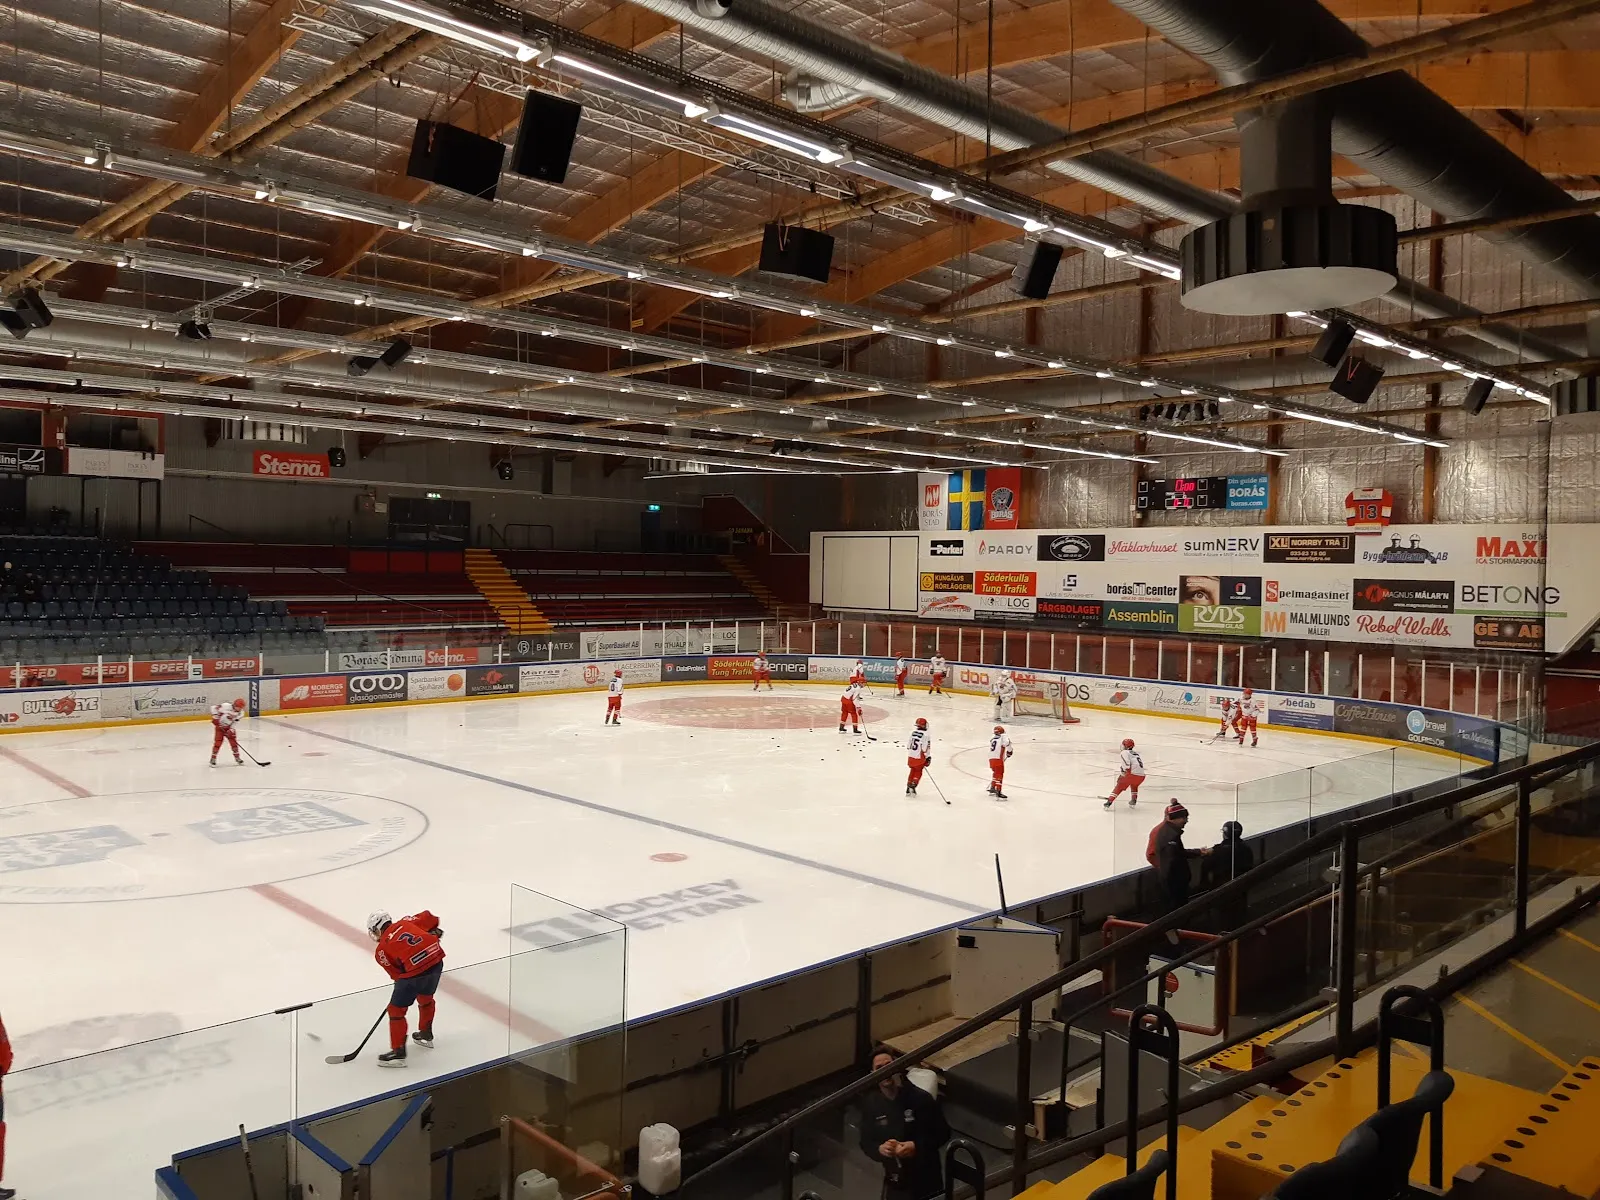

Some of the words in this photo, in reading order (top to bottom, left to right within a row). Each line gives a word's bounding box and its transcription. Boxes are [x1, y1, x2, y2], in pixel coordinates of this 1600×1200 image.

[1240, 477, 1257, 486] guide
[1229, 485, 1266, 497] BORÅS
[922, 508, 943, 518] BORÅS
[990, 509, 1014, 521] BORÅS
[1358, 505, 1377, 519] 13
[924, 519, 940, 527] STAD
[1108, 541, 1178, 554] Mäklarhuset
[1324, 538, 1340, 546] TRÄ
[936, 543, 964, 555] Parker
[1436, 552, 1449, 561] AB
[983, 573, 1029, 582] Söderkulla
[934, 582, 973, 590] RÖRLÄGGERI
[981, 584, 1001, 594] Tung
[1003, 584, 1028, 594] Trafik
[1266, 581, 1350, 601] Spelmagasinet
[1382, 591, 1414, 599] MAGNUS
[1461, 585, 1561, 604] BETONG
[1038, 602, 1101, 615] FÄRGBOLAGET
[1108, 608, 1174, 623] Assemblin
[1193, 605, 1245, 624] RYDS
[1290, 612, 1350, 627] MALMLUNDS
[1308, 626, 1331, 636] MÅLERI
[1356, 614, 1402, 635] Rebel
[1401, 616, 1451, 637] Walls
[536, 642, 574, 651] BAATEX
[599, 641, 631, 650] SuperBasket
[215, 660, 255, 670] SPEED
[343, 654, 379, 670] Borås
[713, 660, 754, 668] Söderkulla
[82, 665, 127, 676] SPEED
[711, 668, 730, 677] Tung
[769, 663, 806, 673] ernera
[842, 666, 854, 674] STA
[410, 676, 445, 684] Sparbanken
[310, 683, 343, 691] MOBERGS
[150, 696, 194, 708] SuperBasket
[195, 696, 206, 704] AB
[350, 692, 405, 703] glasögonmäster
[74, 697, 99, 711] EYE
[1286, 698, 1316, 709] bedab
[1425, 720, 1447, 732] travel
[572, 878, 742, 923] HOCKEY
[625, 894, 763, 931] ETTAN
[397, 931, 423, 947] 2
